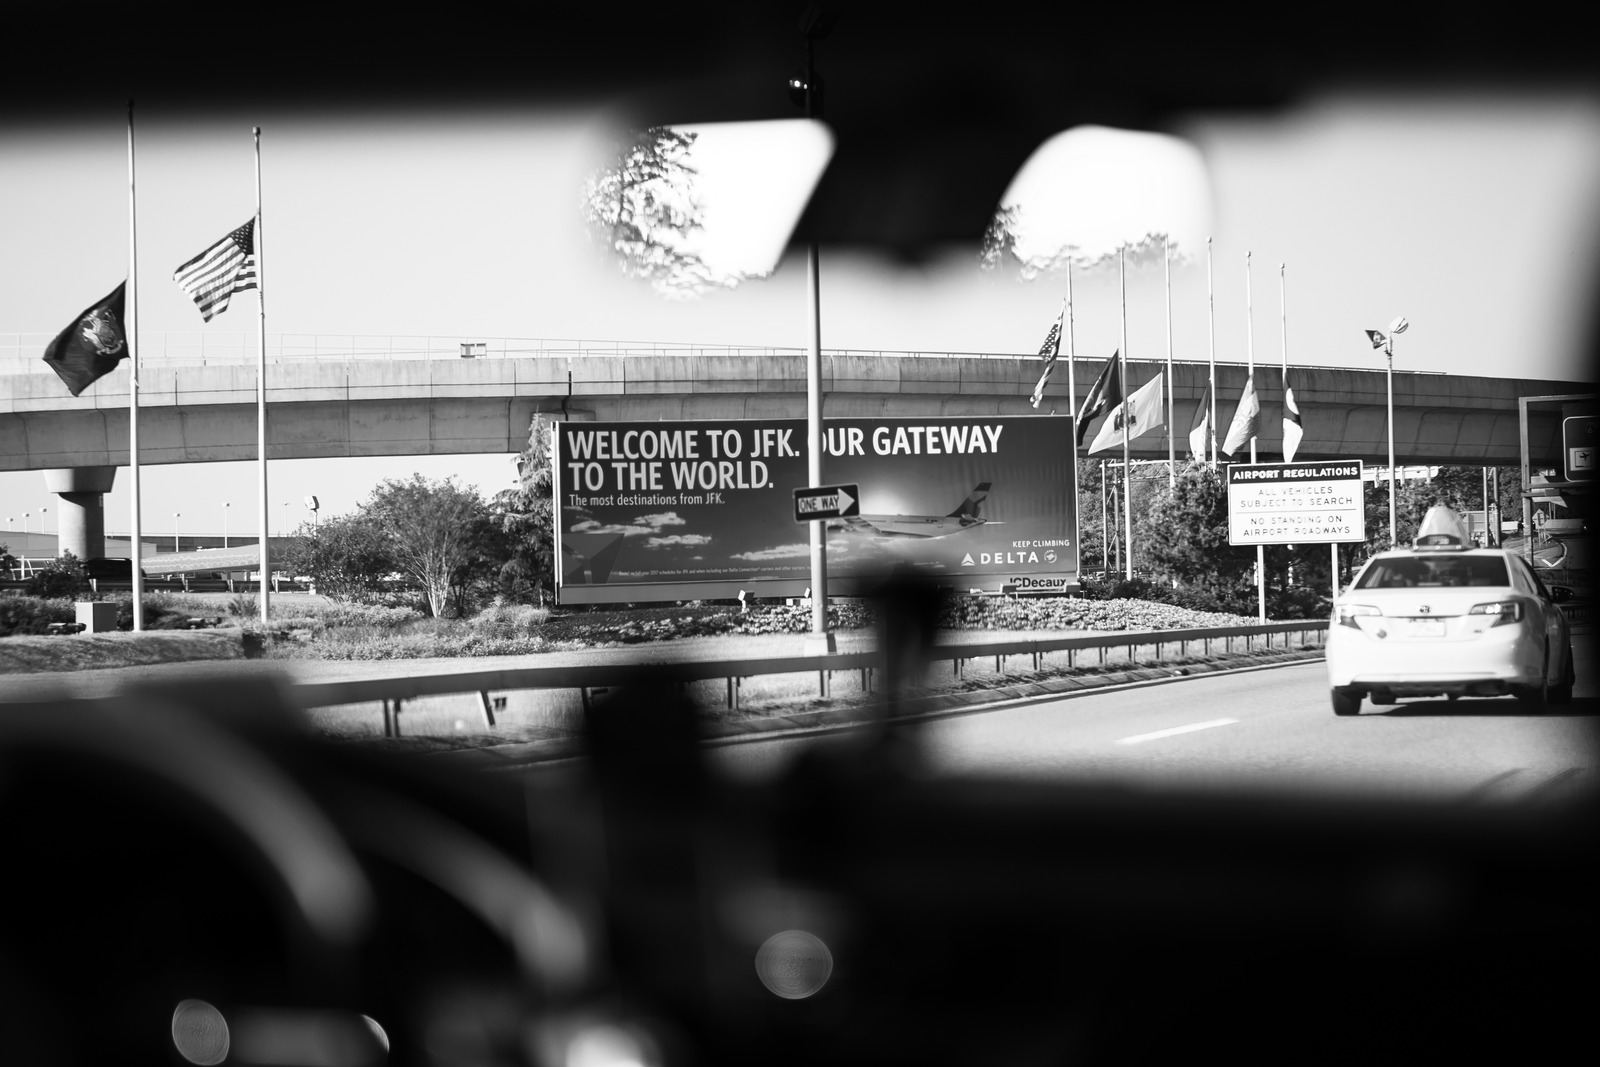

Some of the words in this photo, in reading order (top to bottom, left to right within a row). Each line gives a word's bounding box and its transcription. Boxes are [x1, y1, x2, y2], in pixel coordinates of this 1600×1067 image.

[567, 430, 699, 459] WELCOME
[705, 429, 742, 459] TO
[750, 429, 800, 457] JFK.
[808, 427, 865, 456] UR
[872, 425, 1003, 456] GATEWAY
[568, 461, 604, 491] TO
[611, 461, 663, 491] THE
[670, 460, 774, 490] WORLD.
[1233, 470, 1280, 480] AIRPORT
[1283, 466, 1358, 478] REGULATIONS
[569, 494, 587, 506] The
[590, 494, 614, 506] most
[617, 493, 677, 505] destinations
[680, 492, 703, 505] from
[705, 492, 725, 505] JFK.
[799, 498, 818, 512] ONE
[821, 495, 839, 510] WAY
[1240, 499, 1287, 508] SUBJECT
[1292, 498, 1303, 506] TO
[1310, 497, 1353, 506] SEARCH
[1271, 516, 1322, 525] STANDING
[1328, 515, 1342, 523] ON
[1243, 528, 1288, 536] AIRPORT
[1294, 526, 1351, 534] ROADWAYS
[1012, 540, 1031, 548] KEEP
[1032, 539, 1070, 548] CLIMBING
[980, 551, 1039, 564] DELTA
